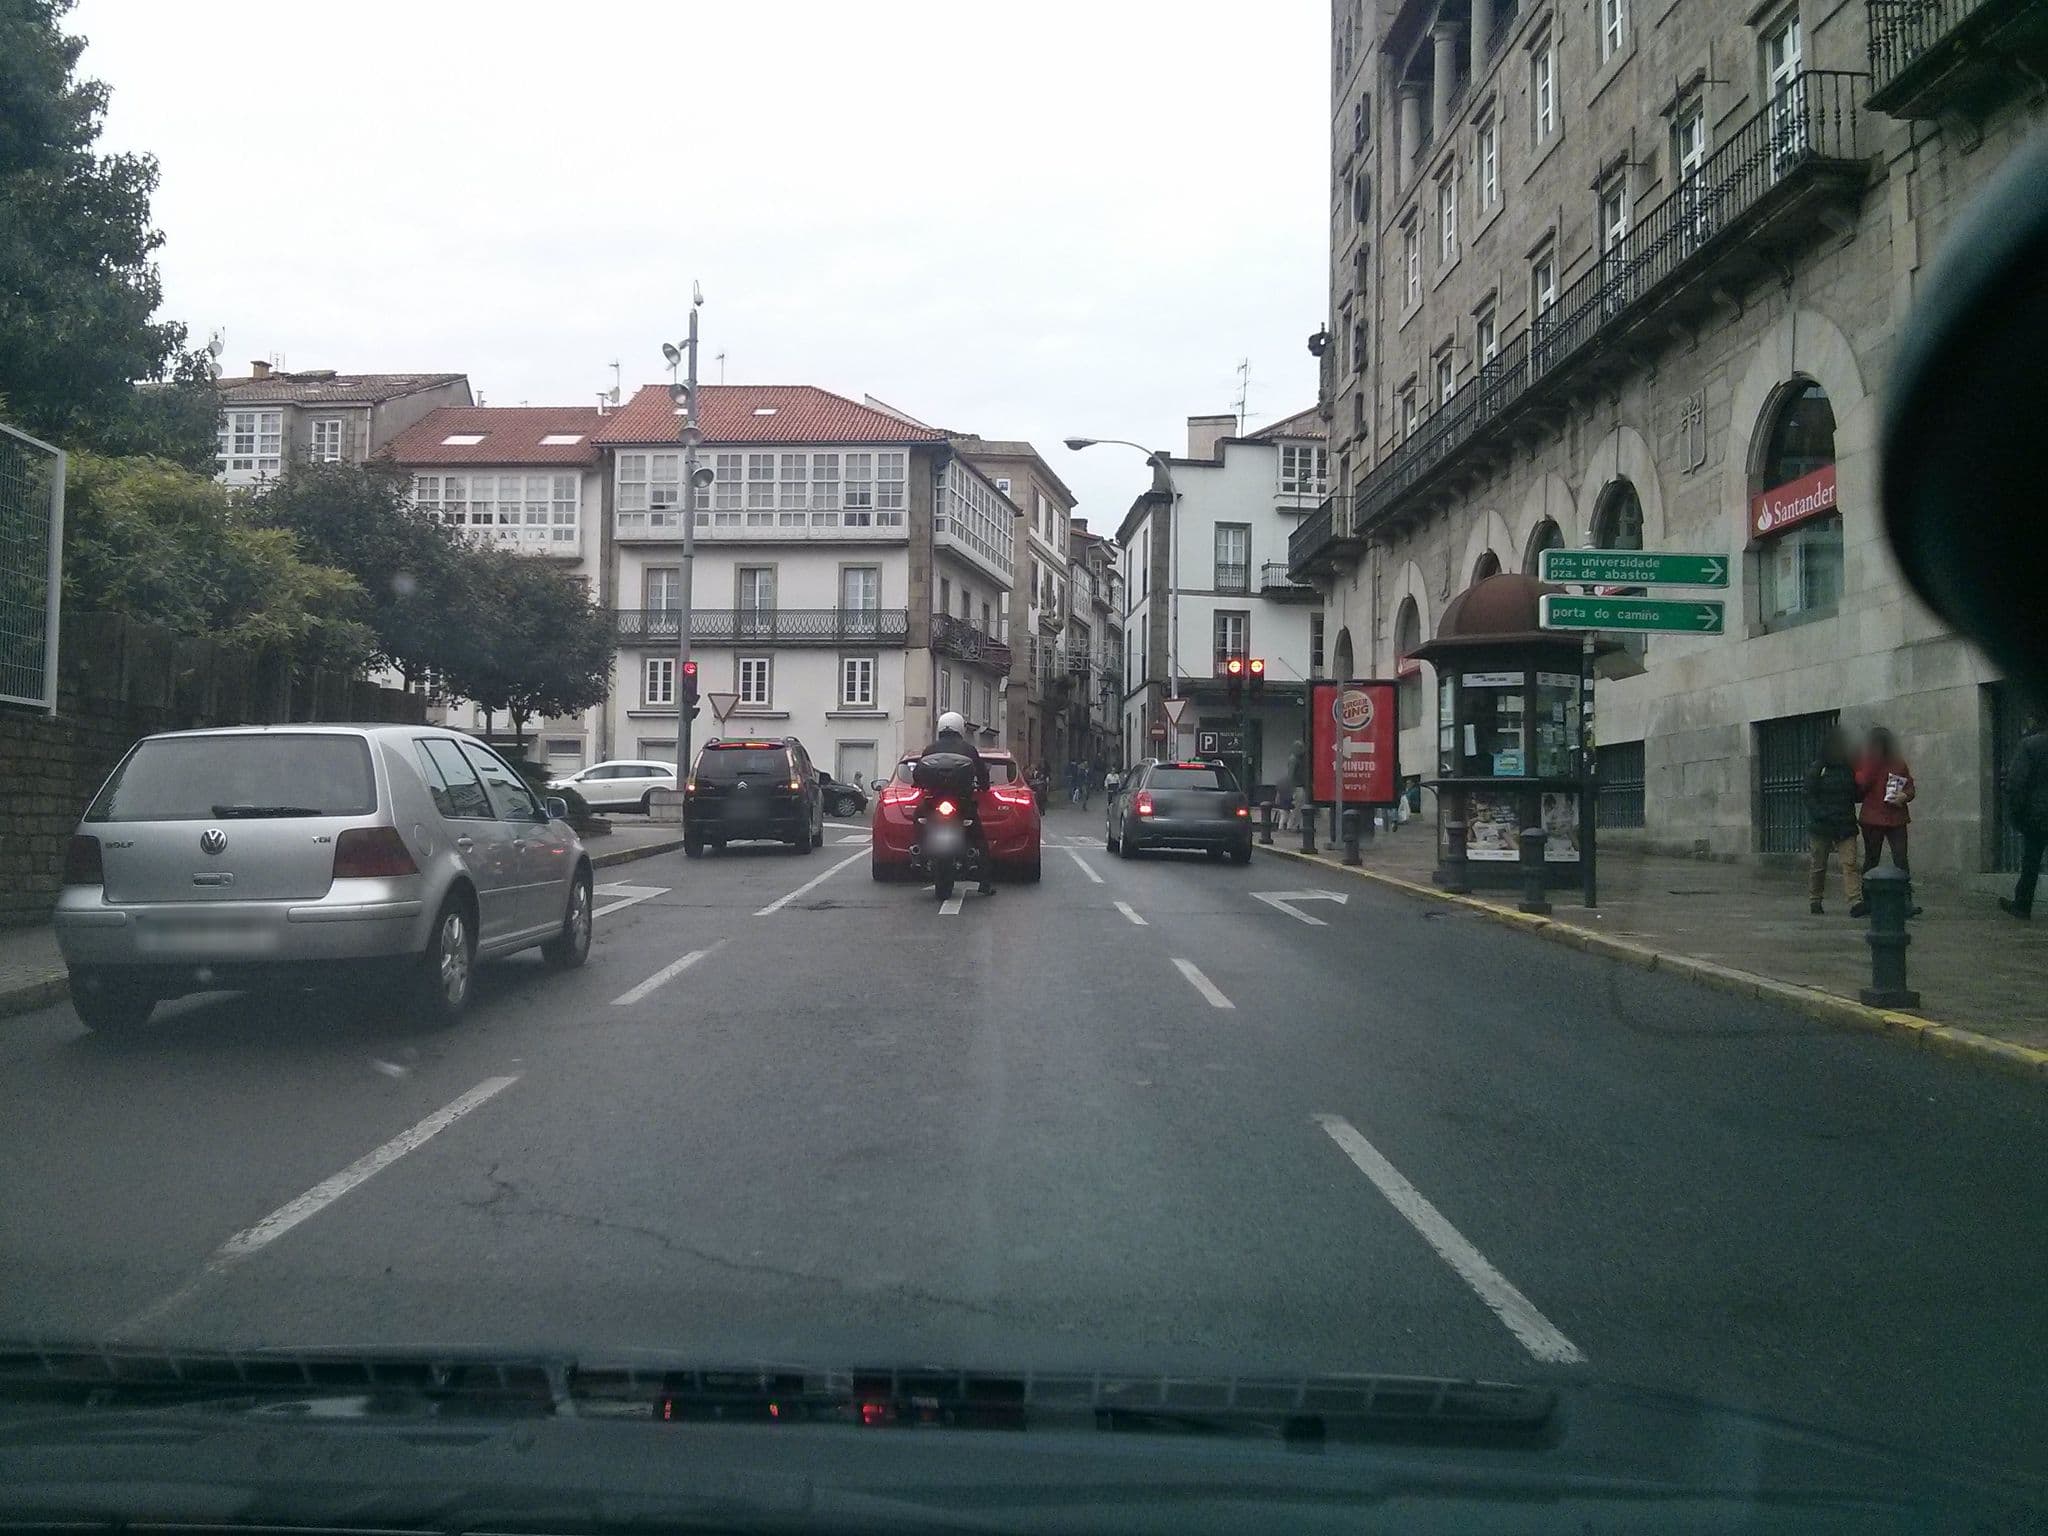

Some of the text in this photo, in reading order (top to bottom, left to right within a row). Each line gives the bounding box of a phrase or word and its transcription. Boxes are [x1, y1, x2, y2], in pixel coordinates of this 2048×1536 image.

[1352, 91, 1371, 443] HOTEL
[1774, 480, 1835, 524] Santander
[1550, 556, 1661, 569] pza. universidade
[1550, 569, 1657, 581] pza. de abastos
[1552, 608, 1586, 620] porta
[1594, 608, 1610, 620] do
[1204, 735, 1213, 750] P
